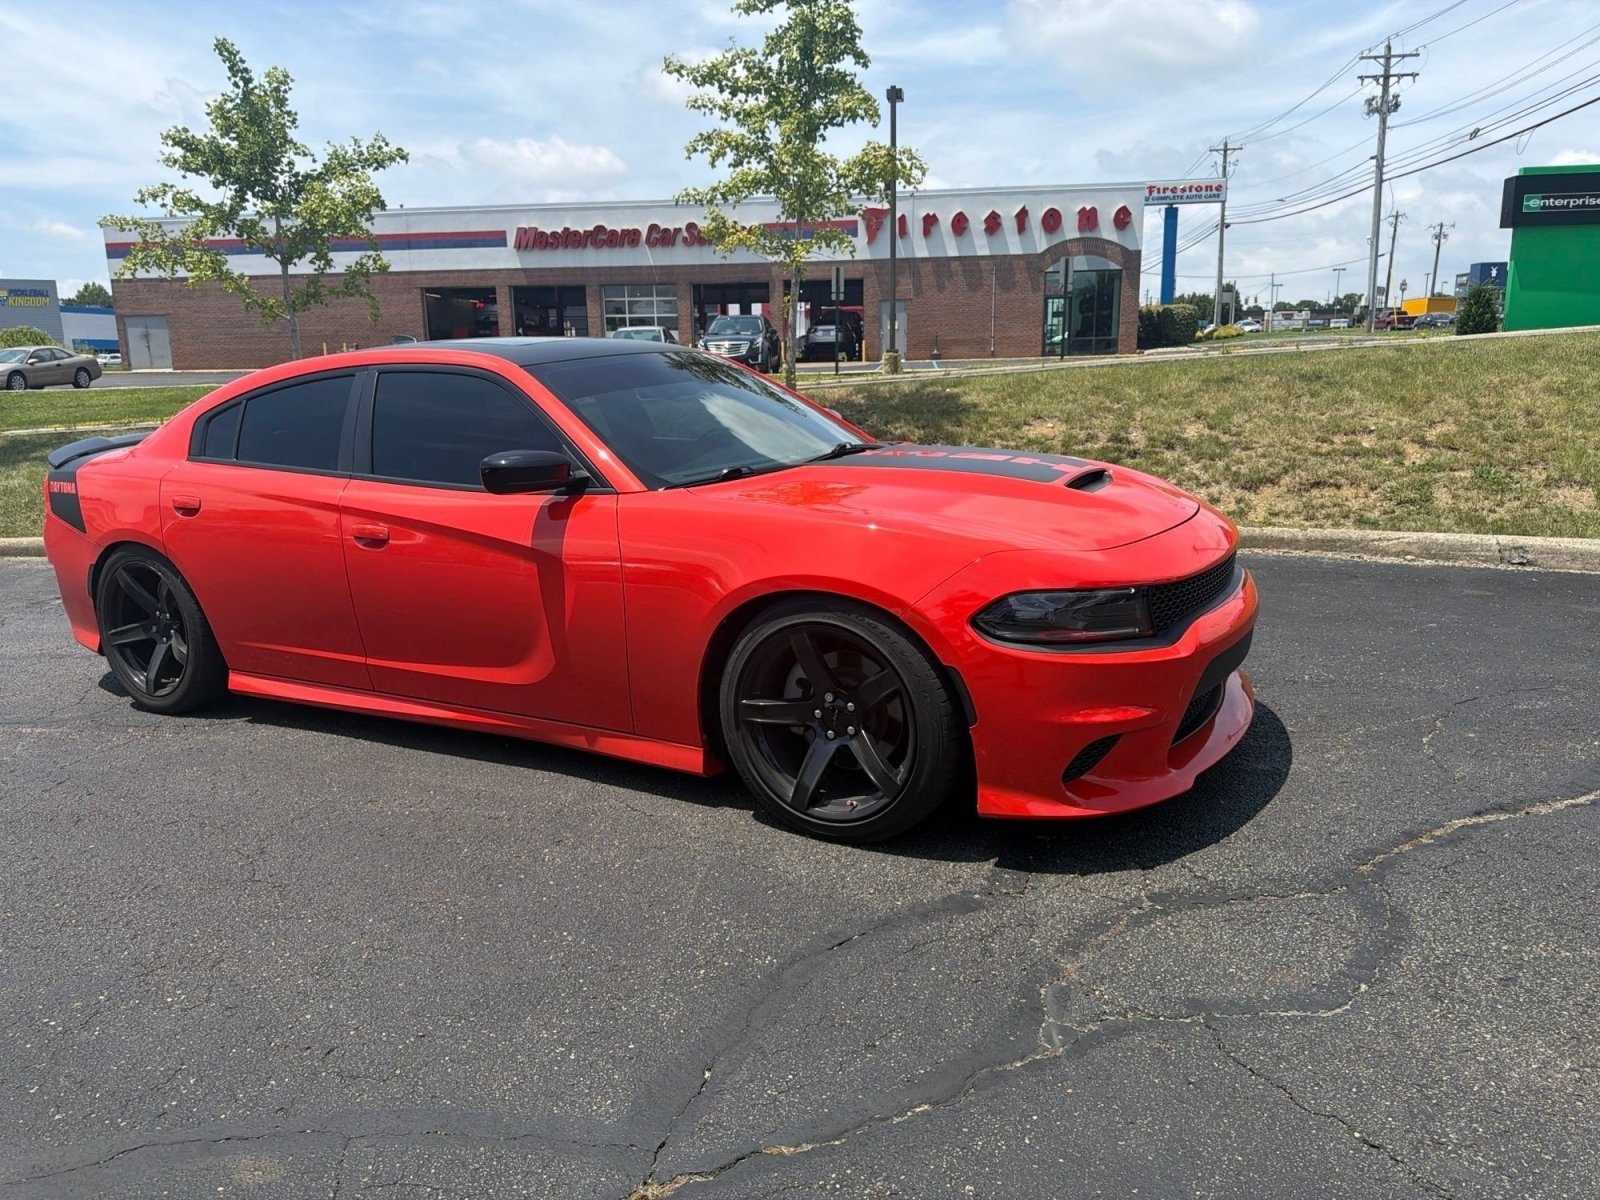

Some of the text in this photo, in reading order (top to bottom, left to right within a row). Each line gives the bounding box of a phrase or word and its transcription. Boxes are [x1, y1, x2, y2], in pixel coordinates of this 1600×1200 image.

[1146, 184, 1223, 196] Firestone
[1151, 194, 1184, 202] COMPLETE
[863, 204, 1133, 245] Firestone
[514, 225, 641, 250] MasterCare
[645, 223, 682, 246] Car
[8, 296, 50, 307] KINGDOM
[49, 481, 76, 494] DAYTONA
